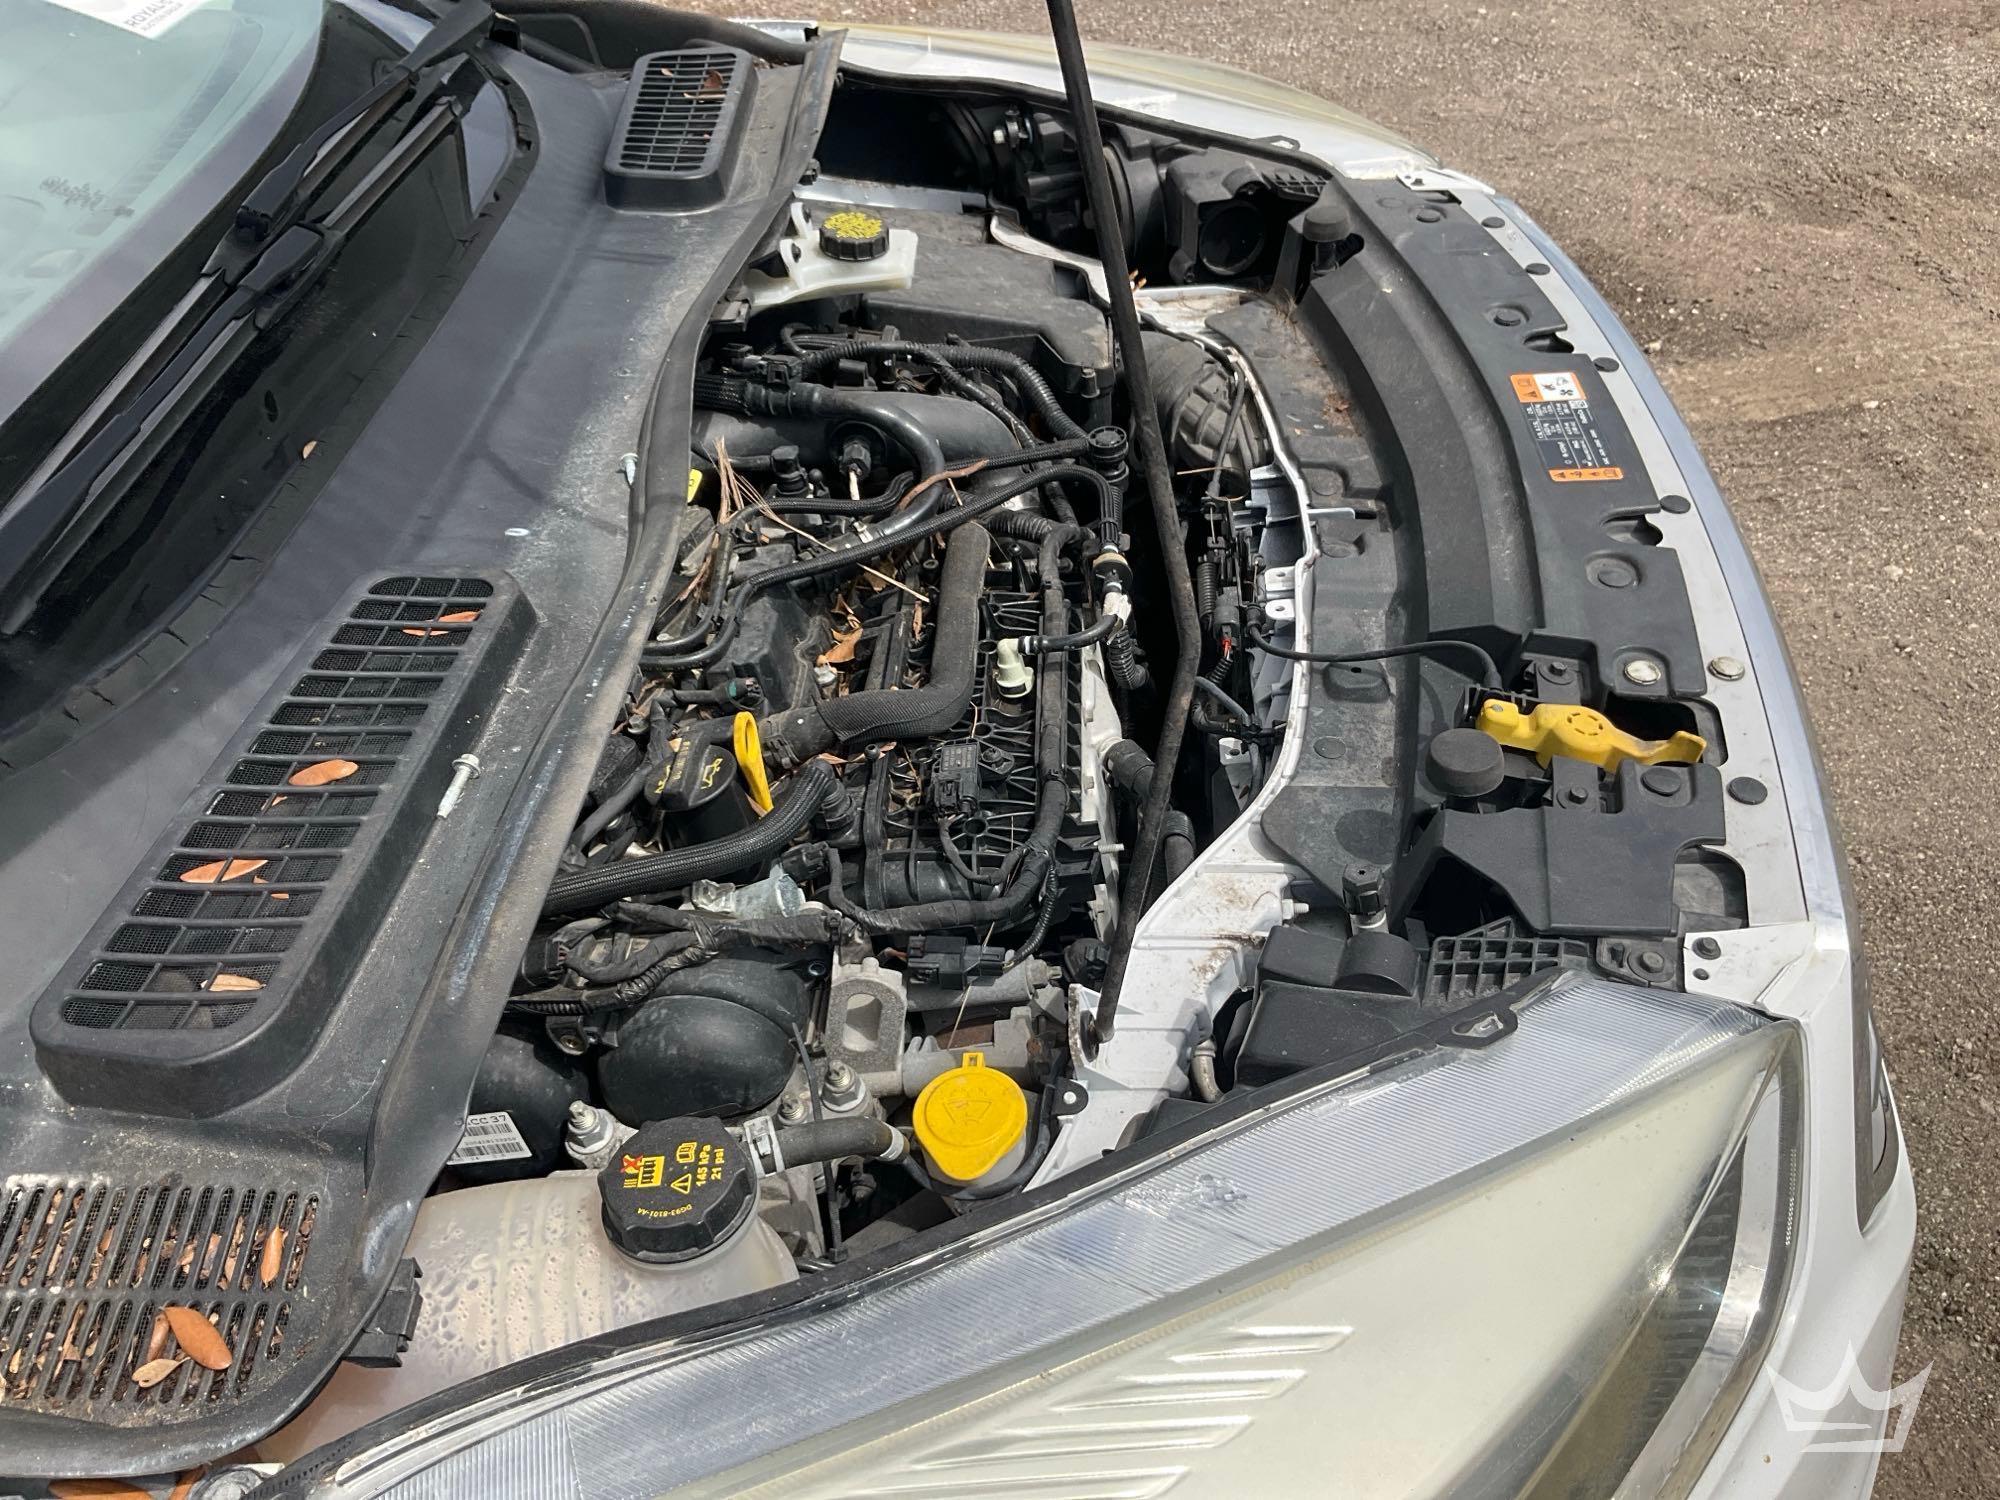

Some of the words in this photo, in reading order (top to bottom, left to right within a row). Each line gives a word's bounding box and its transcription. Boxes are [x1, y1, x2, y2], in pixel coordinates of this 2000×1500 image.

[490, 1114, 506, 1123] 37
[699, 1144, 711, 1165] kPa
[714, 1148, 725, 1164] psi
[696, 1167, 708, 1187] 145
[711, 1167, 722, 1180] 21
